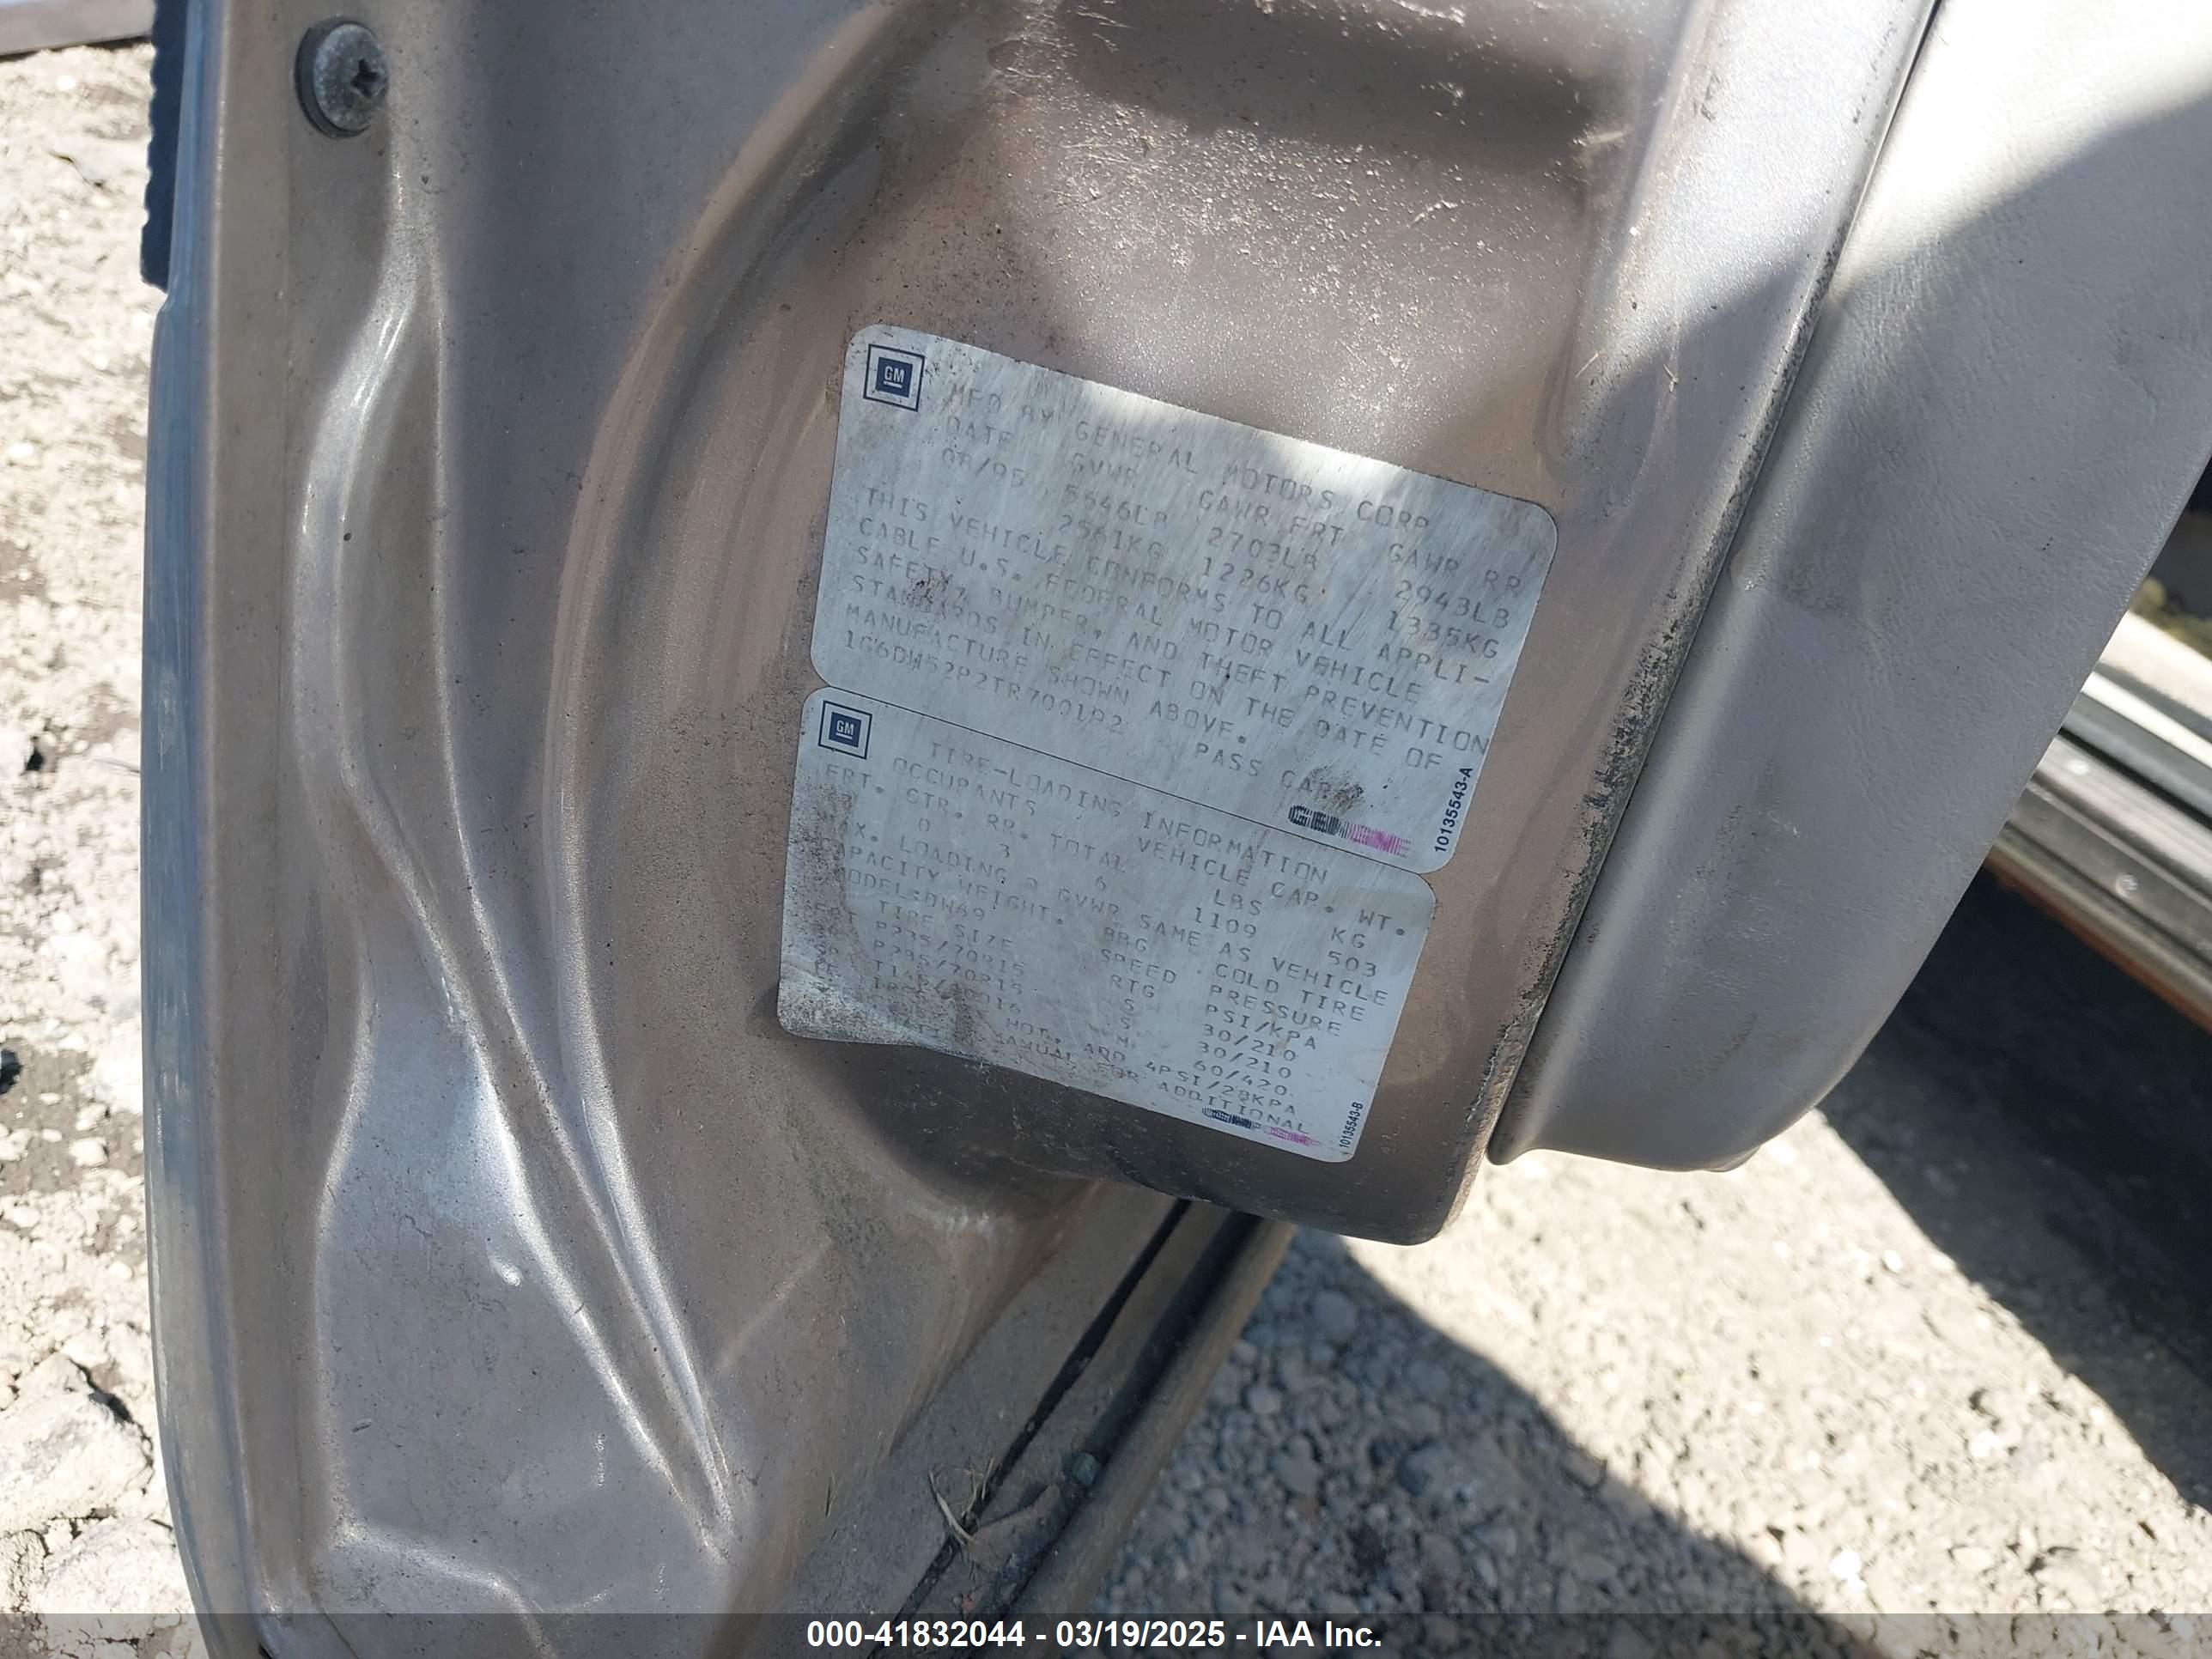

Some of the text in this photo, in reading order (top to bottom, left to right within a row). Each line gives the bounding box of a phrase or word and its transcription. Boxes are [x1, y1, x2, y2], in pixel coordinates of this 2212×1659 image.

[883, 365, 905, 384] GM
[945, 414, 1523, 599] DATE GVWR GAWR FRT GAWR RR
[947, 381, 1431, 538] MFD BY GENERAL MOTORS CORP
[858, 515, 1424, 704] CABLE U.S. FEDERAL MOTOR VEHICLE
[865, 487, 1492, 692] THIS VEHICLE CONFORMS TO ALL APPLI-
[1200, 556, 1310, 605] 1226KG
[1386, 609, 1501, 660] 1335KG
[1207, 525, 1320, 575] 2703LB
[1395, 578, 1512, 630] 2943LB
[844, 601, 1249, 744] MANUFACTURE SHOWN ABOVE.
[855, 544, 1491, 757] SAFETY, BUMPER, AND THEFT PREVENTION
[1020, 626, 1050, 652] IN
[1067, 641, 1171, 690] EFFECT
[1188, 678, 1226, 708] ON
[1242, 696, 1294, 730] THE
[1314, 718, 1389, 757] DATE
[1403, 745, 1443, 775] OF
[835, 719, 855, 736] GM
[1194, 741, 1262, 778] PASS
[824, 761, 1367, 951] FRT. CTR. RR. TOTAL LBS KG
[891, 756, 1407, 937] OCCUPANTS VEHICLE CAP. WT.
[929, 741, 1328, 886] TIRE-LOADING INFORMATION
[1432, 764, 1474, 855] 10135543-A
[898, 835, 1007, 884] LOADING
[1056, 886, 1121, 920] GVWR
[1137, 913, 1202, 948] SAME
[1218, 940, 1252, 963] AS
[1268, 956, 1389, 1007] VEHICLE
[917, 817, 931, 834] 0
[998, 842, 1012, 860] 3
[1094, 875, 1109, 892] 6
[1192, 906, 1258, 940] 1109
[1325, 949, 1379, 979] 503
[957, 878, 1065, 926] WEIGHT.
[1213, 962, 1280, 995] COLD
[1297, 988, 1366, 1023] TIRE
[877, 899, 1319, 1050] TIRE SIZE RTG PSI/KPA
[1098, 947, 1178, 985] SPEED
[1207, 982, 1344, 1037] PRESSURE
[1121, 997, 1136, 1012] S
[1200, 1022, 1298, 1064] 30/210
[1083, 1041, 1126, 1065] ADD
[1144, 1059, 1297, 1116] 4PSI/28KPA
[1118, 1015, 1132, 1030] S
[1196, 1039, 1293, 1081] 30/210
[1158, 1079, 1310, 1135] ADDITIONAL
[1193, 1057, 1288, 1097] 60/420
[1339, 1101, 1364, 1150] 10135543-B
